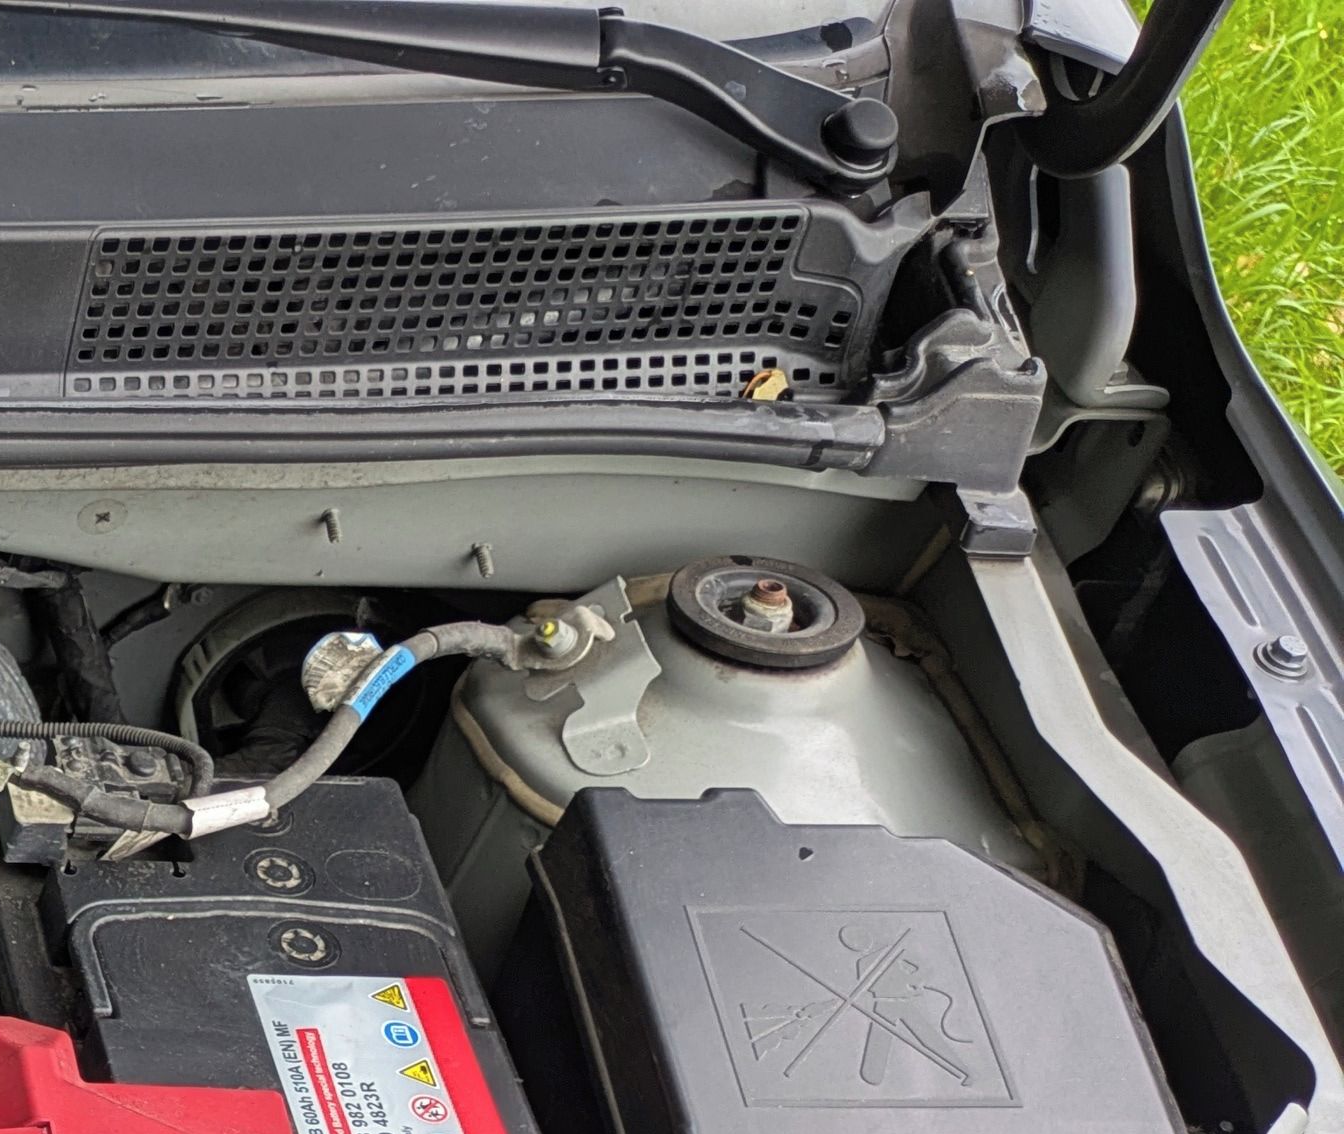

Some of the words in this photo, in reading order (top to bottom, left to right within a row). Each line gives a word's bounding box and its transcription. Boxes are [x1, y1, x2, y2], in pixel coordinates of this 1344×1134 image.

[272, 1020, 291, 1037] MF
[278, 1040, 303, 1063] (EN)
[304, 1031, 324, 1075] technology
[287, 1066, 309, 1093] 510A
[316, 1074, 333, 1101] special
[332, 1062, 357, 1098] 0108
[298, 1096, 321, 1125] 60Ah
[327, 1100, 343, 1128] Battery
[345, 1102, 368, 1128] 982
[359, 1081, 389, 1128] 4823R
